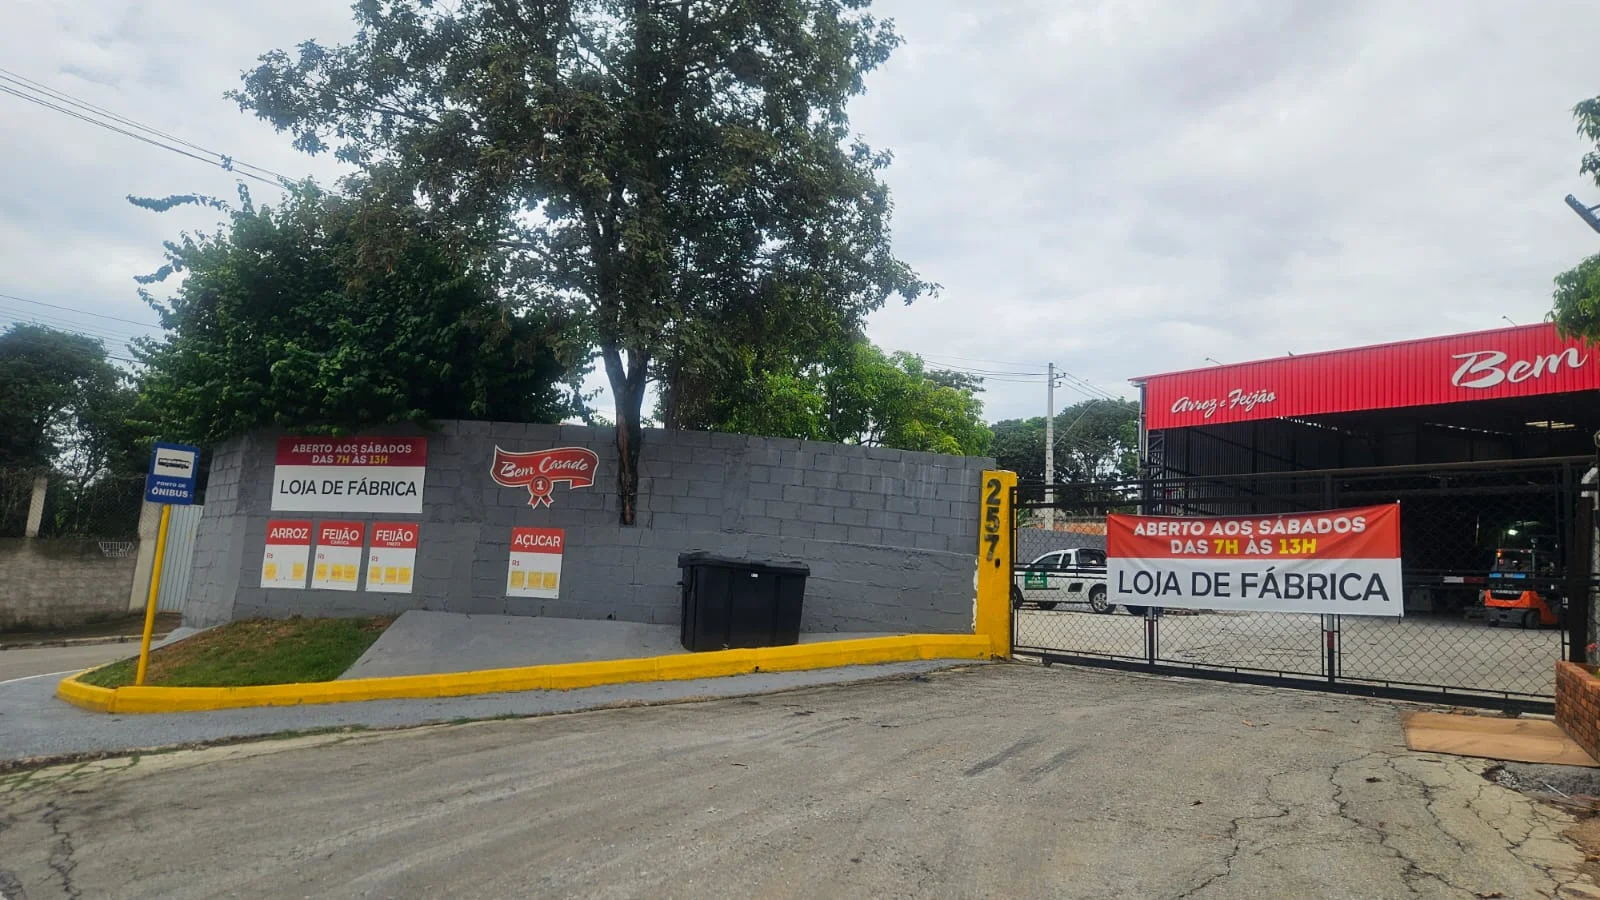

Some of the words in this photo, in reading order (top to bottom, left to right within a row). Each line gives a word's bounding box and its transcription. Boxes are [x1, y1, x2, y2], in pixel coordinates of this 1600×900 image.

[1451, 347, 1588, 388] Bem
[1171, 396, 1217, 418] Arroz
[1219, 399, 1226, 407] e
[1228, 388, 1276, 412] Feijão
[292, 443, 333, 453] ABERTO
[335, 443, 358, 453] AOS
[360, 442, 412, 454] SÁBADOS
[312, 454, 334, 464] DAS
[336, 455, 350, 464] 7H
[352, 453, 367, 464] ÀS
[368, 455, 388, 464] 13H
[501, 461, 536, 478] Bem
[539, 456, 589, 473] Casado
[151, 486, 189, 498] ÔNIBUS
[280, 479, 317, 495] LOJA
[322, 480, 343, 495] DE
[347, 477, 417, 496] FÁBRICA
[536, 480, 544, 491] 1
[1134, 520, 1206, 537] ABERTO
[1209, 520, 1253, 536] AOS
[1258, 515, 1367, 535] SÁBADOS
[270, 527, 308, 540] ARROZ
[322, 527, 360, 541] FEIJÃO
[375, 529, 414, 542] FEIJÃO
[514, 534, 561, 548] AÇUCAR
[1170, 539, 1209, 554] DAS
[1214, 539, 1239, 555] 7H
[1244, 534, 1273, 555] ÀS
[1279, 538, 1317, 554] 13H
[1118, 570, 1182, 597] LOJA
[1191, 571, 1231, 598] DE
[1241, 566, 1390, 602] FÁBRICA
